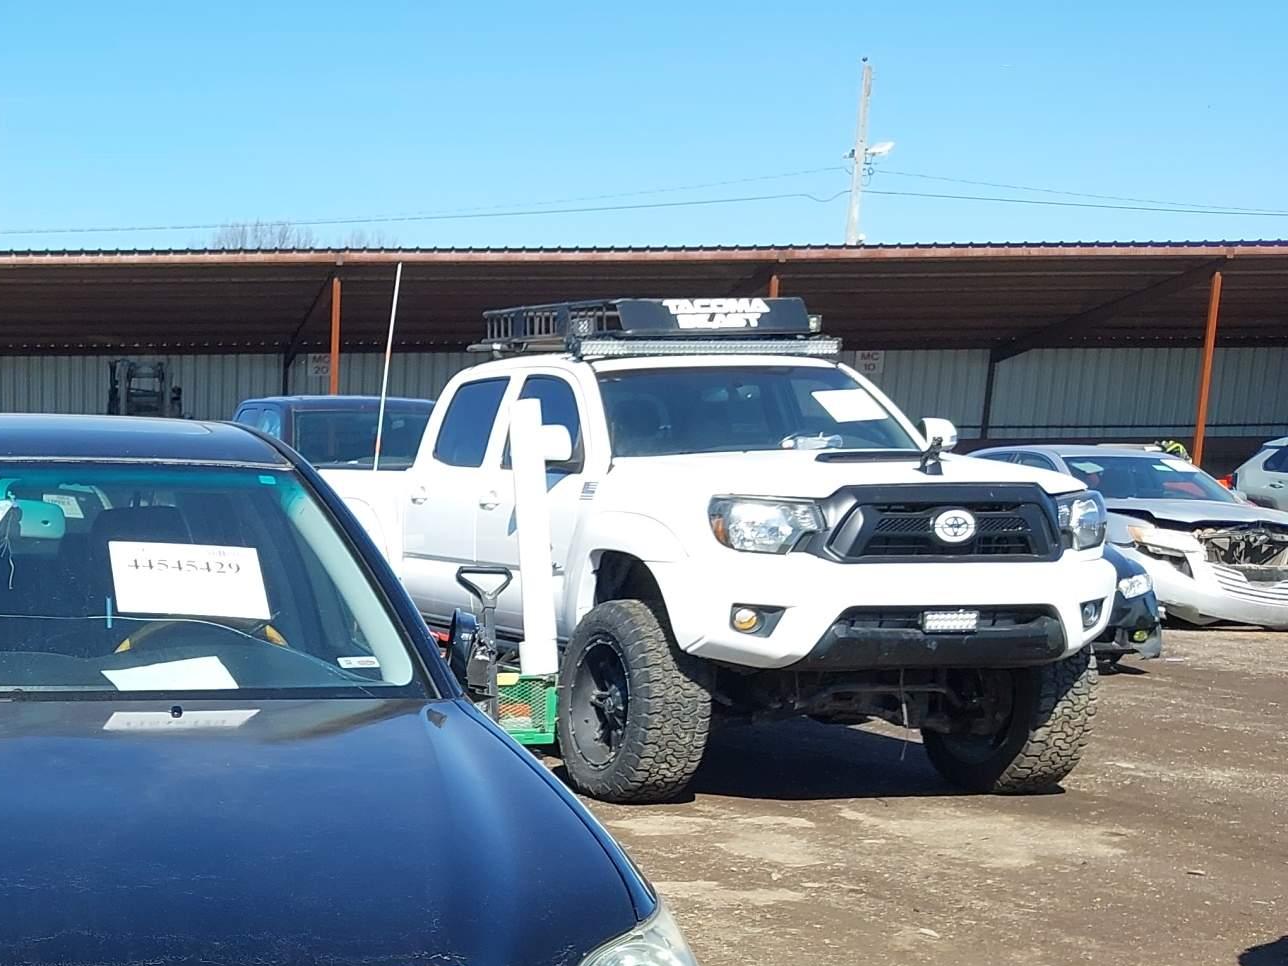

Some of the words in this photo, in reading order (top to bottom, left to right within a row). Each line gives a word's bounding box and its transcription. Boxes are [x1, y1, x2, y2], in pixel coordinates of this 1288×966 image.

[662, 298, 770, 314] TACOMA
[861, 351, 880, 361] MC
[312, 366, 329, 375] 20
[864, 363, 876, 371] 10
[127, 558, 241, 574] 44545429
